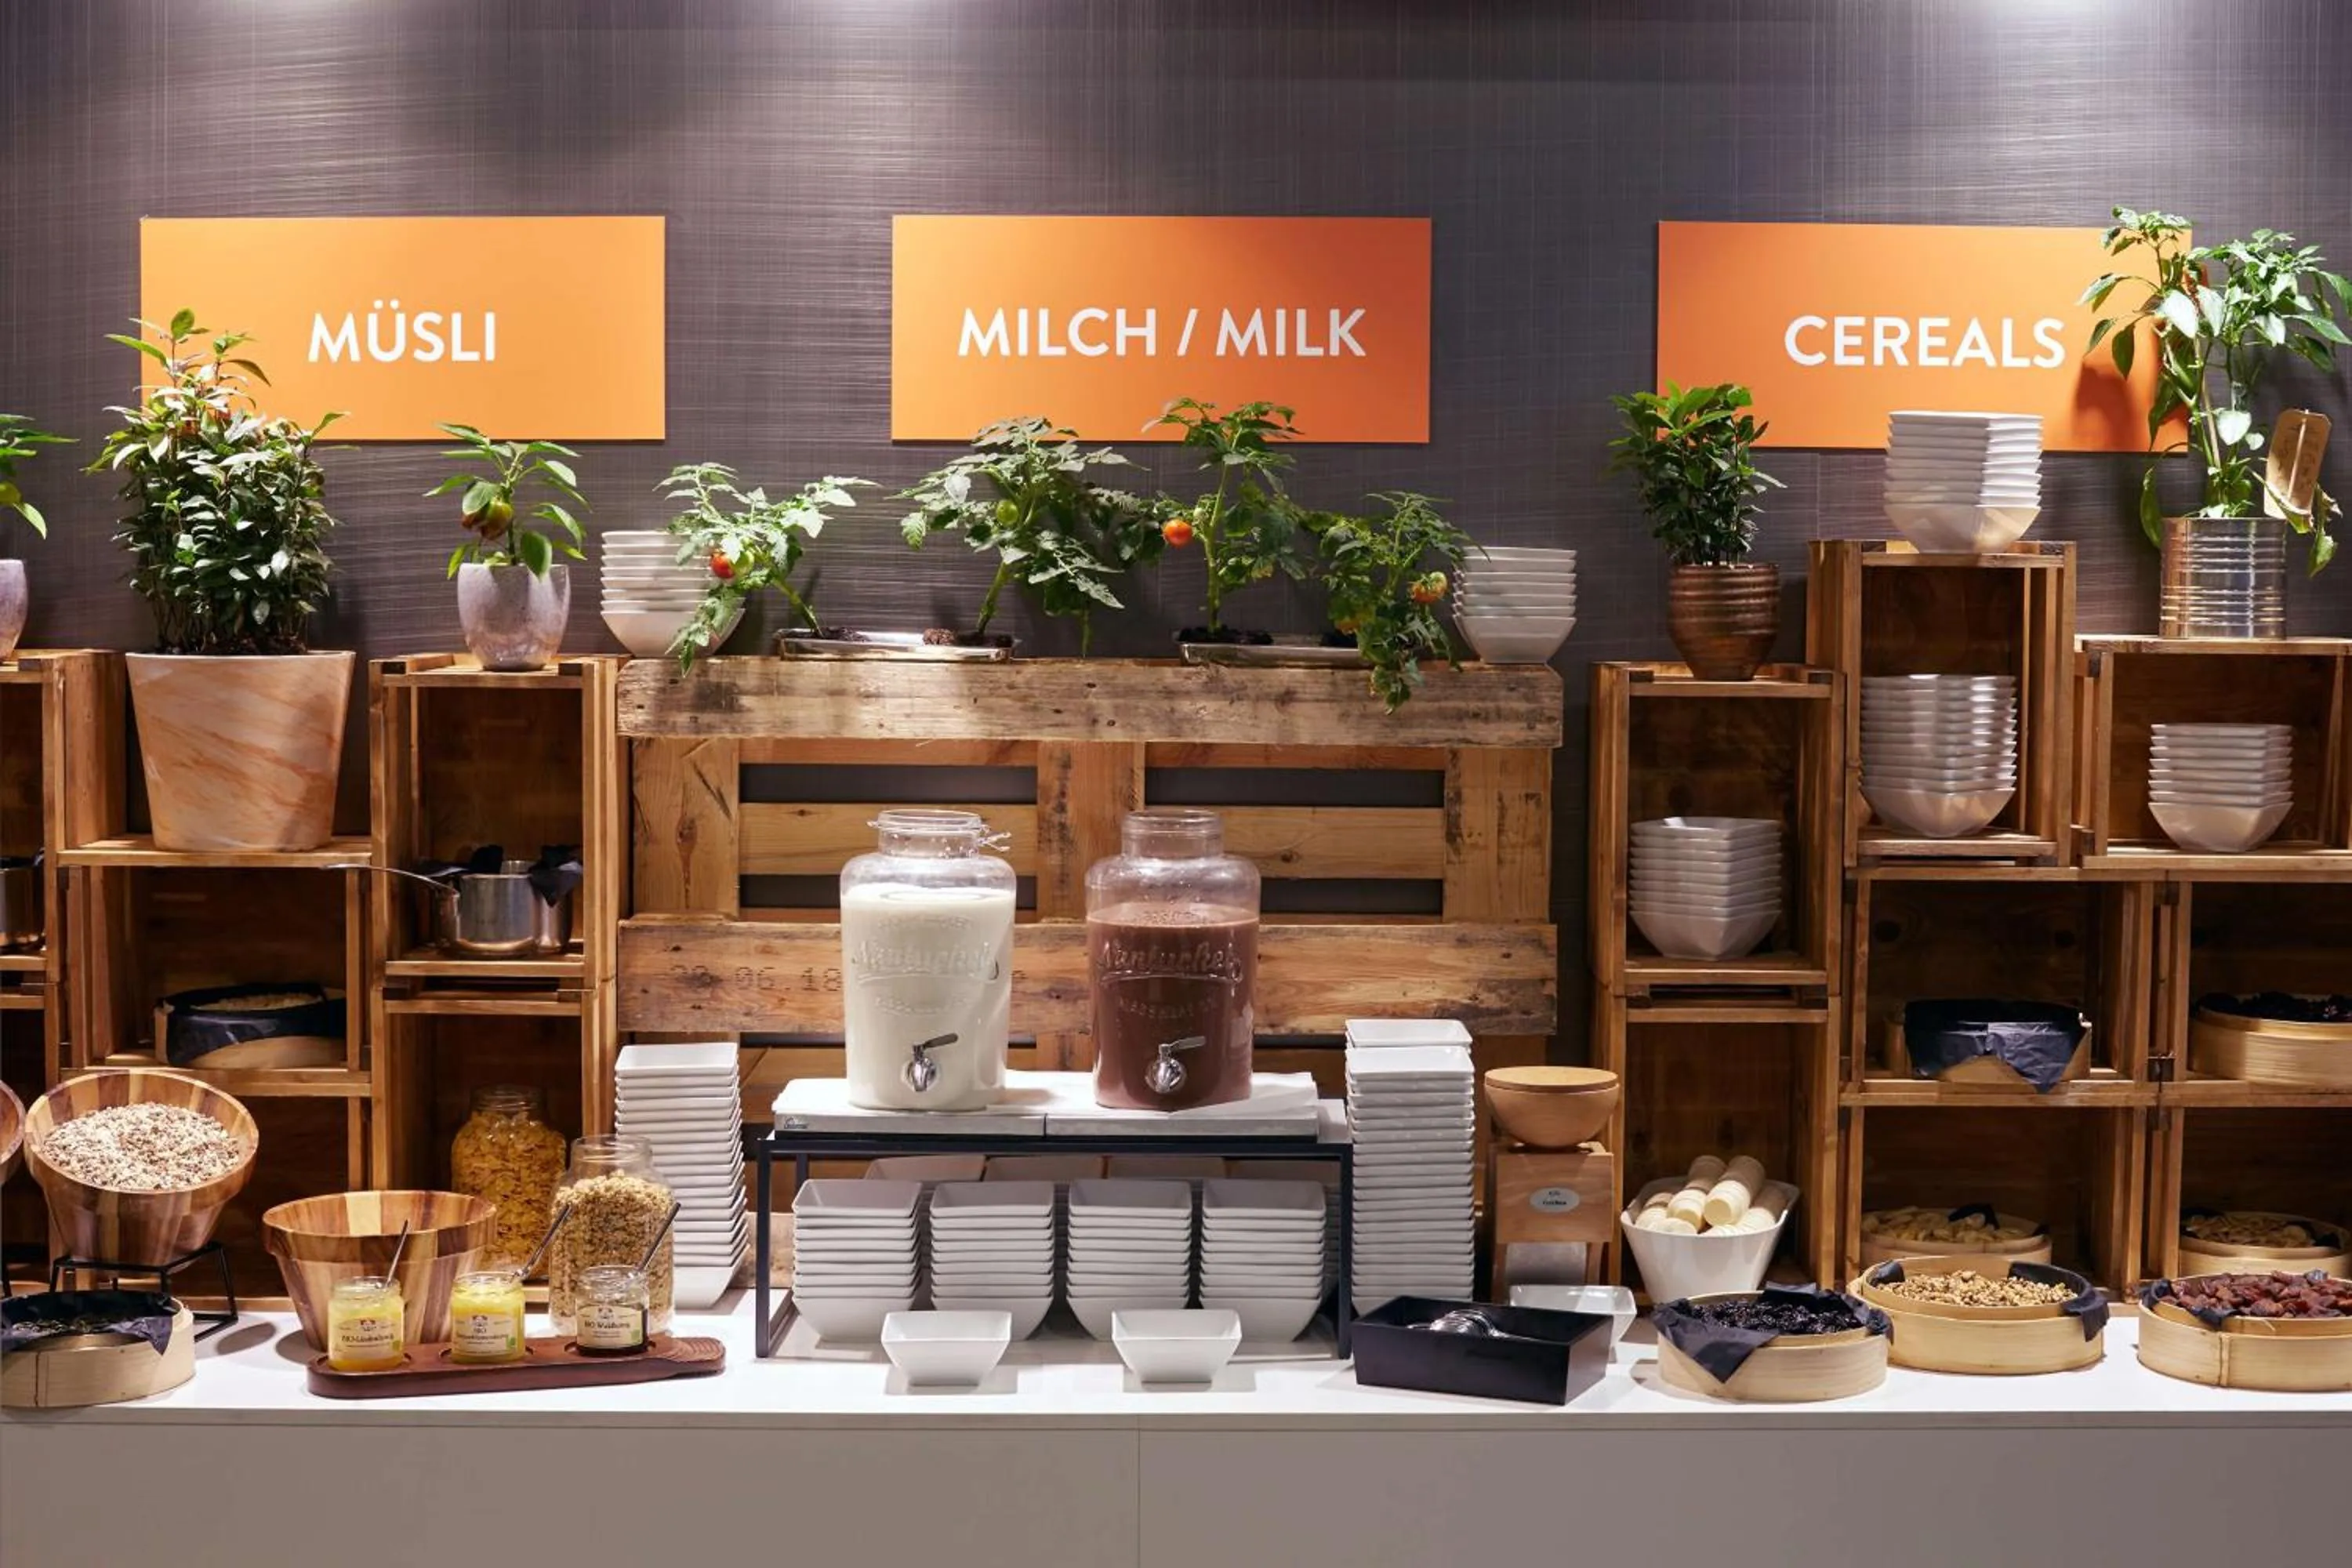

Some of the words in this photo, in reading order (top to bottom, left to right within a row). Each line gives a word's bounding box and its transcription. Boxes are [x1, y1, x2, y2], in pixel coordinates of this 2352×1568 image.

[307, 299, 495, 363] MÜSLI
[957, 307, 1156, 358] MILCH
[1178, 308, 1197, 356] /
[1216, 308, 1365, 357] MILK
[1784, 314, 2067, 369] CEREALS
